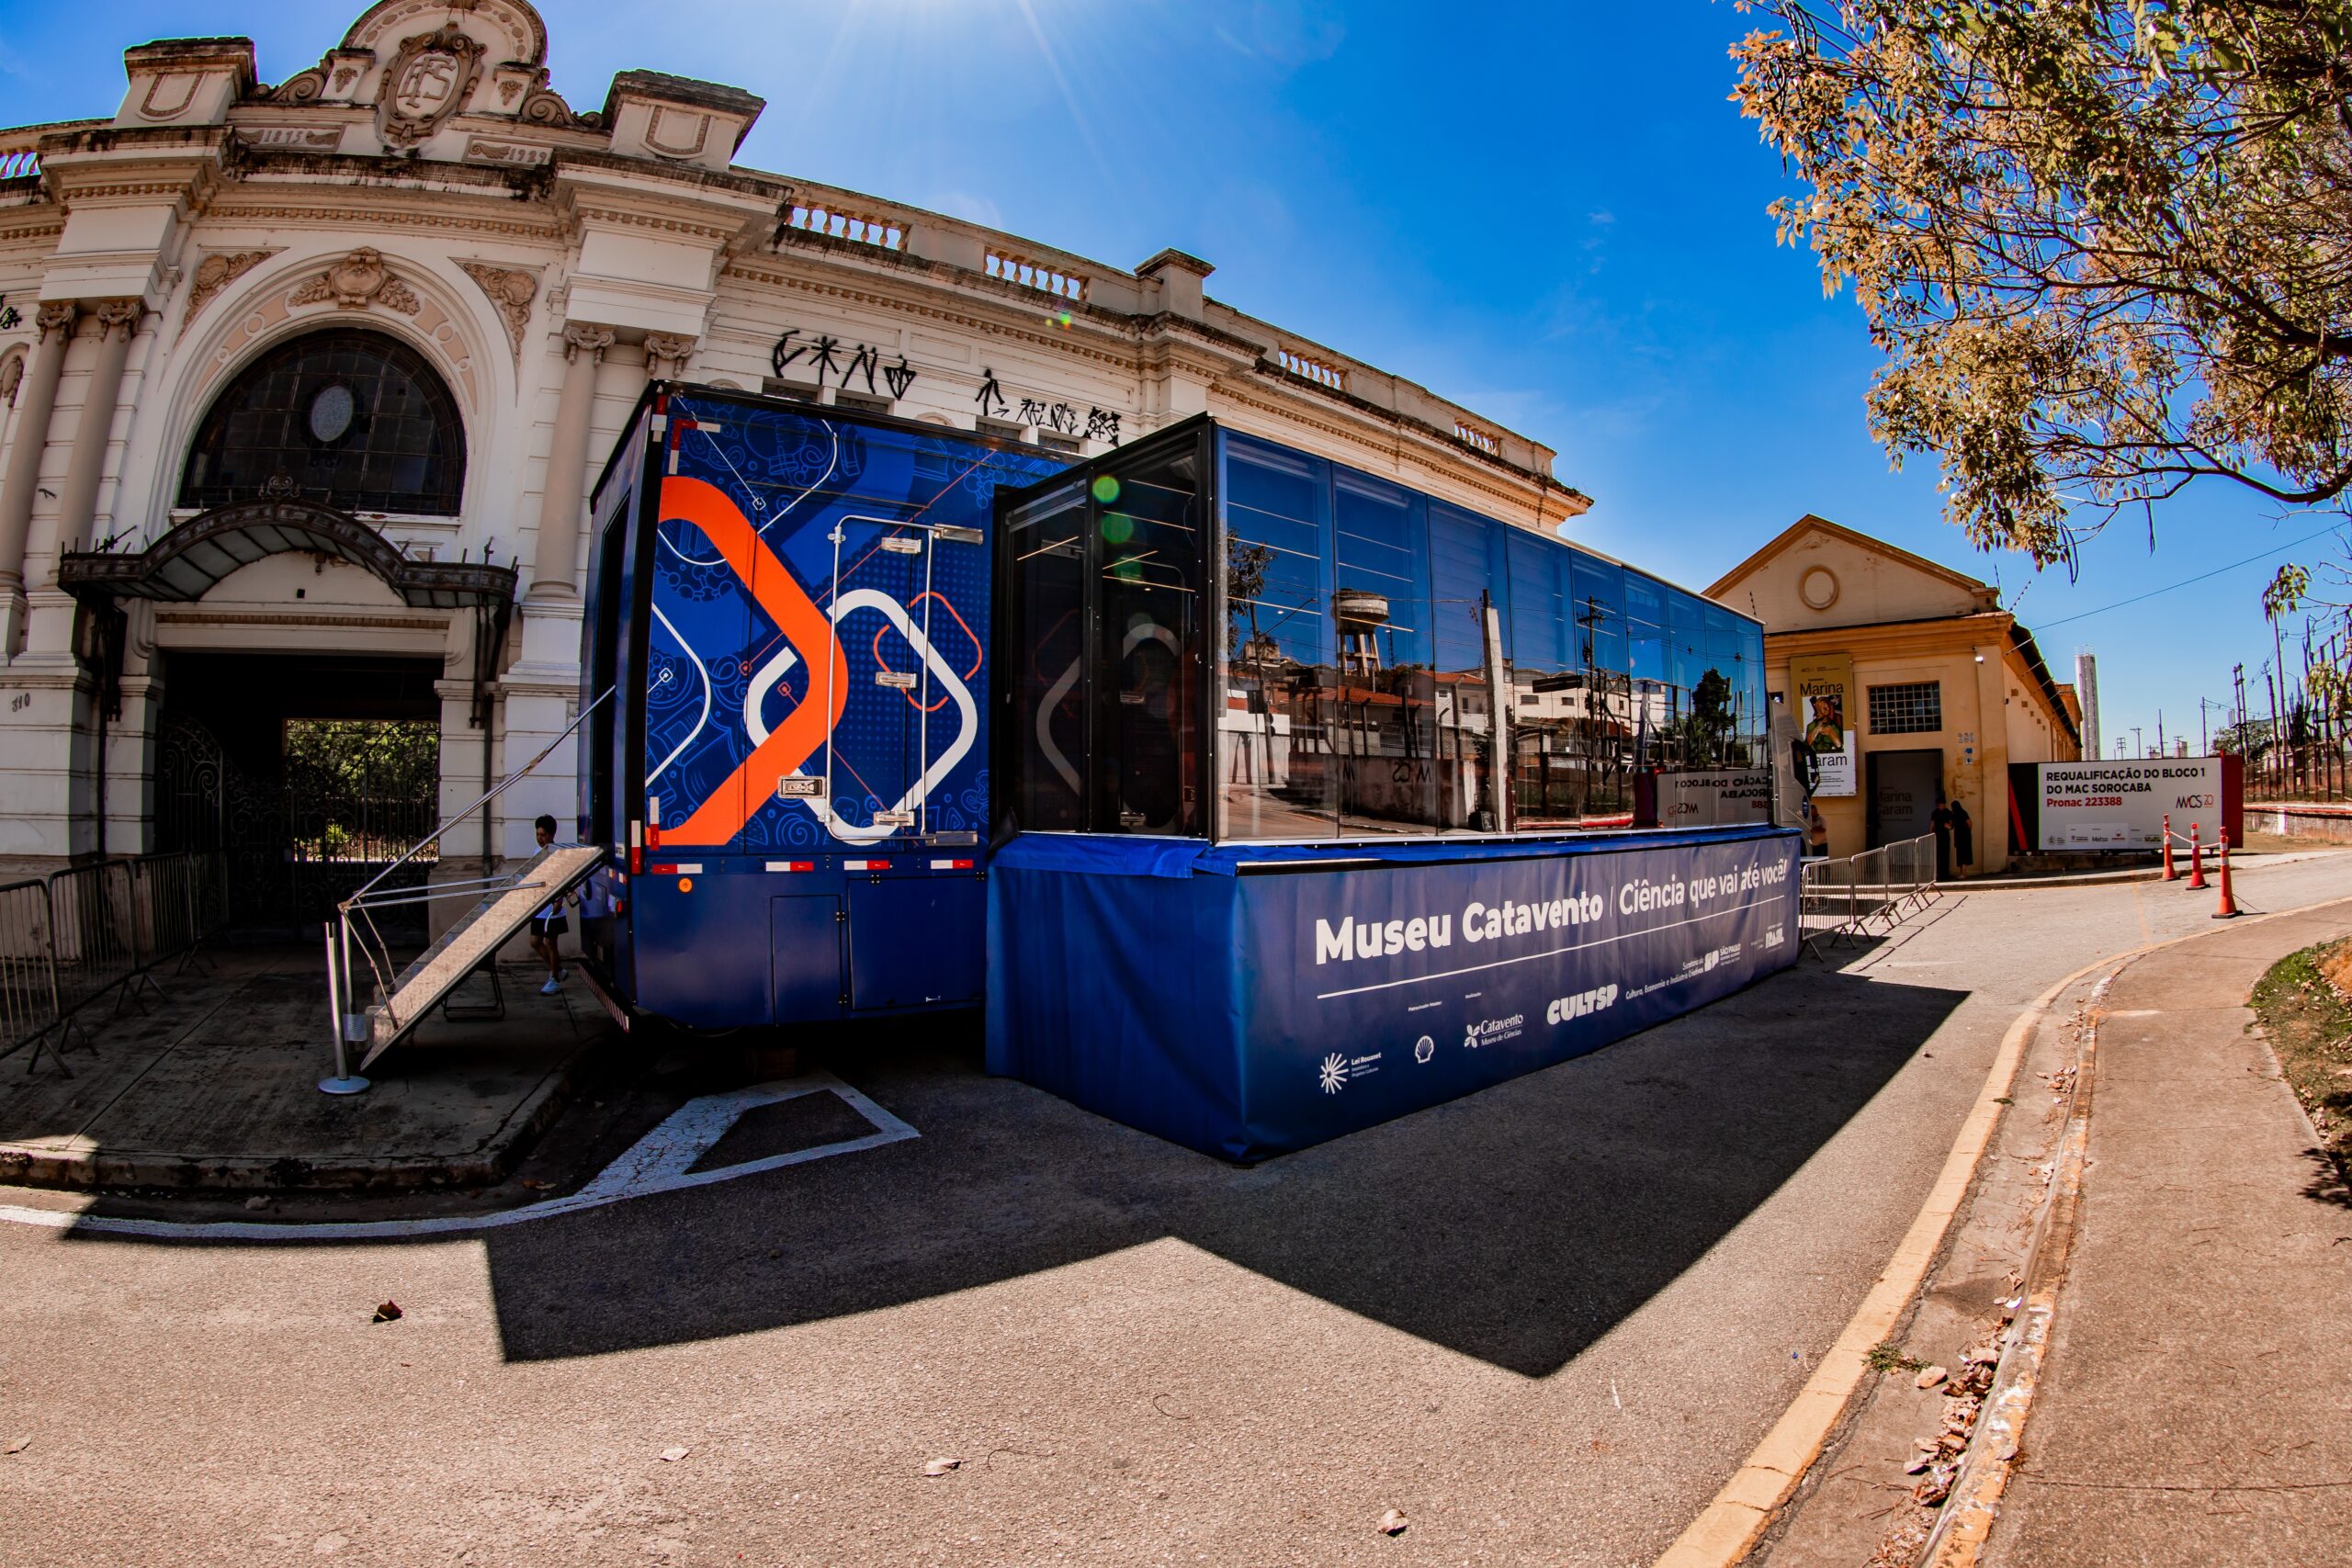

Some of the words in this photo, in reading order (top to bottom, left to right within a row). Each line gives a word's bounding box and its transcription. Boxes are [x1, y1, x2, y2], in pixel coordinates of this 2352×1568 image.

[508, 148, 548, 164] 1929
[1800, 681, 1844, 695] Marina
[12, 692, 30, 712] 310
[1808, 755, 1848, 766] aram
[2046, 768, 2141, 782] REQUALIFICAÇÃO
[2144, 769, 2159, 779] DO
[2163, 768, 2198, 778] BLOCO
[2200, 768, 2205, 777] 1
[2046, 785, 2062, 795] DO
[2065, 784, 2088, 795] MAC
[2092, 783, 2152, 793] SOROCABA
[2046, 797, 2082, 807] Pronac
[2085, 796, 2122, 807] 223388
[1316, 914, 1452, 964] Museu
[1462, 891, 1603, 943] Catavento
[1619, 874, 1685, 915] Ciência
[1690, 877, 1716, 908] que
[1719, 864, 1738, 895] vai
[1740, 862, 1759, 891] até
[1761, 858, 1788, 886] você!
[1546, 984, 1618, 1025] CULTSP
[1480, 1013, 1523, 1035] Catavento
[1481, 1036, 1497, 1046] Museu
[1497, 1033, 1504, 1042] de
[1503, 1029, 1522, 1039] Ciências
[1351, 1056, 1360, 1066] Lei
[1360, 1052, 1382, 1063] Rouanet
